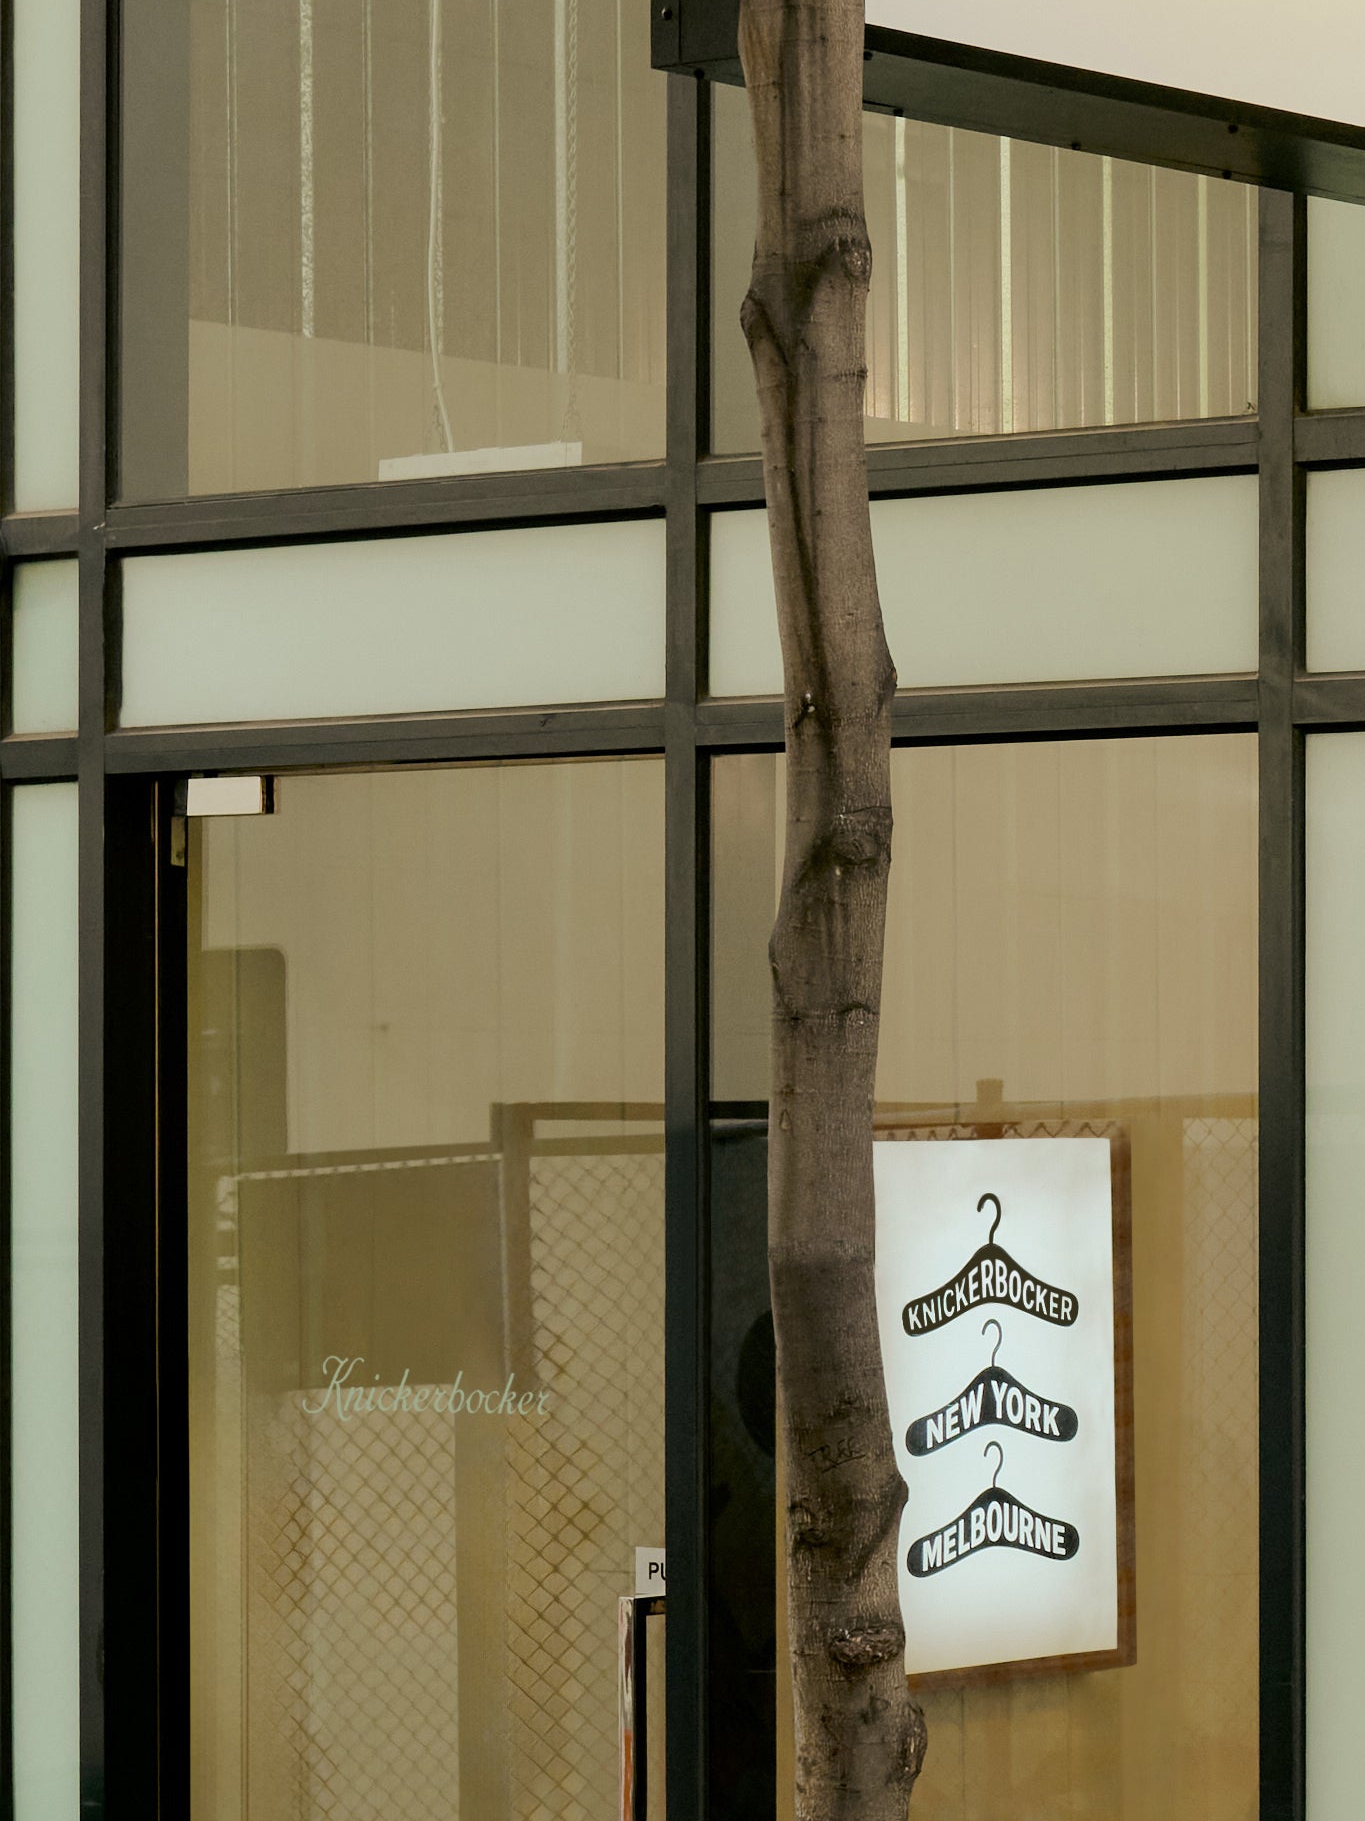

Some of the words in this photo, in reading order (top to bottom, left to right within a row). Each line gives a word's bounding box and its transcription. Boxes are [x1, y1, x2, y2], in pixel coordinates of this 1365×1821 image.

[908, 1259, 1073, 1332] KNICKERBOCKER
[302, 1355, 551, 1422] Knickerbocker
[926, 1382, 986, 1449] NEW
[991, 1380, 1061, 1437] YORK
[648, 1562, 666, 1580] PU
[921, 1500, 1067, 1573] MELBOURNE
